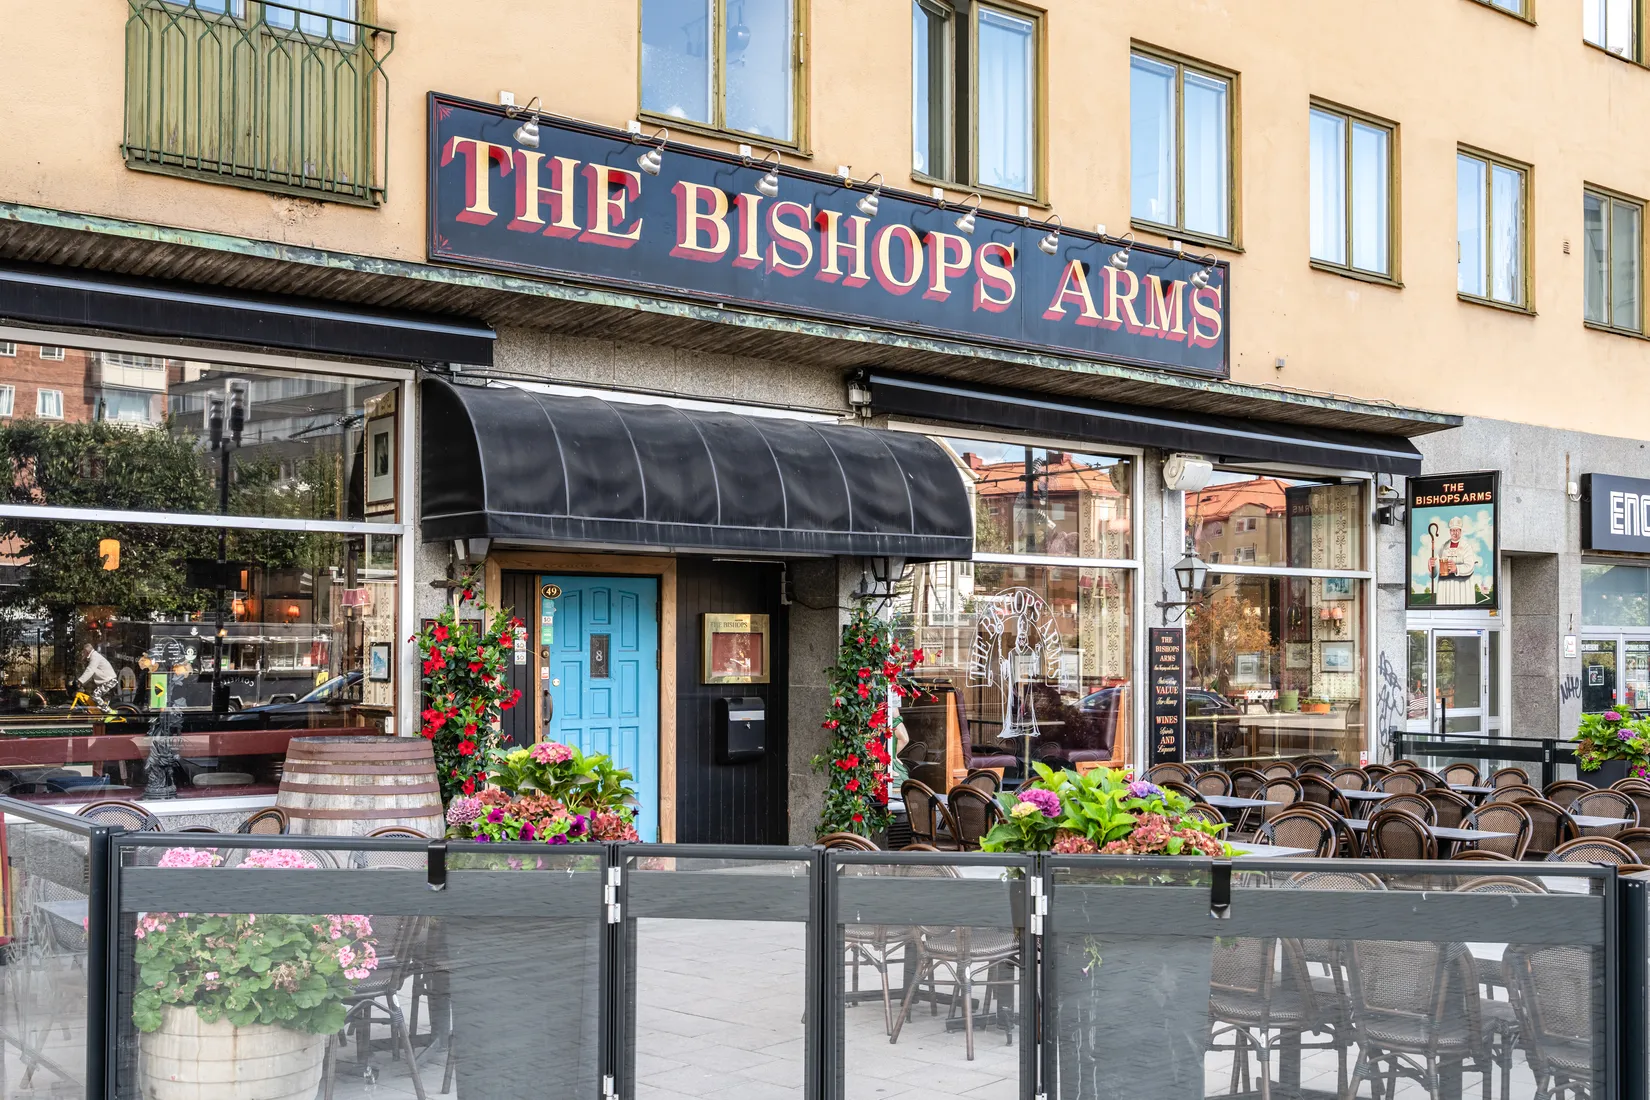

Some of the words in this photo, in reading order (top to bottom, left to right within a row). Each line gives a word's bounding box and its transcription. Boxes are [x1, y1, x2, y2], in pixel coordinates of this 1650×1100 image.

[440, 136, 644, 249] THE
[670, 181, 1016, 312] BISHOPS
[1042, 259, 1222, 348] ARMS
[1443, 483, 1465, 492] THE
[1416, 494, 1460, 505] BISHOPS
[1461, 491, 1492, 503] ARMS
[546, 587, 557, 596] 49
[979, 591, 1043, 640] BISHOPS
[1038, 618, 1063, 679] ARMS
[969, 635, 992, 680] THE
[1155, 685, 1179, 694] VALUE
[1155, 715, 1178, 724] WINES
[1160, 736, 1175, 745] AND
